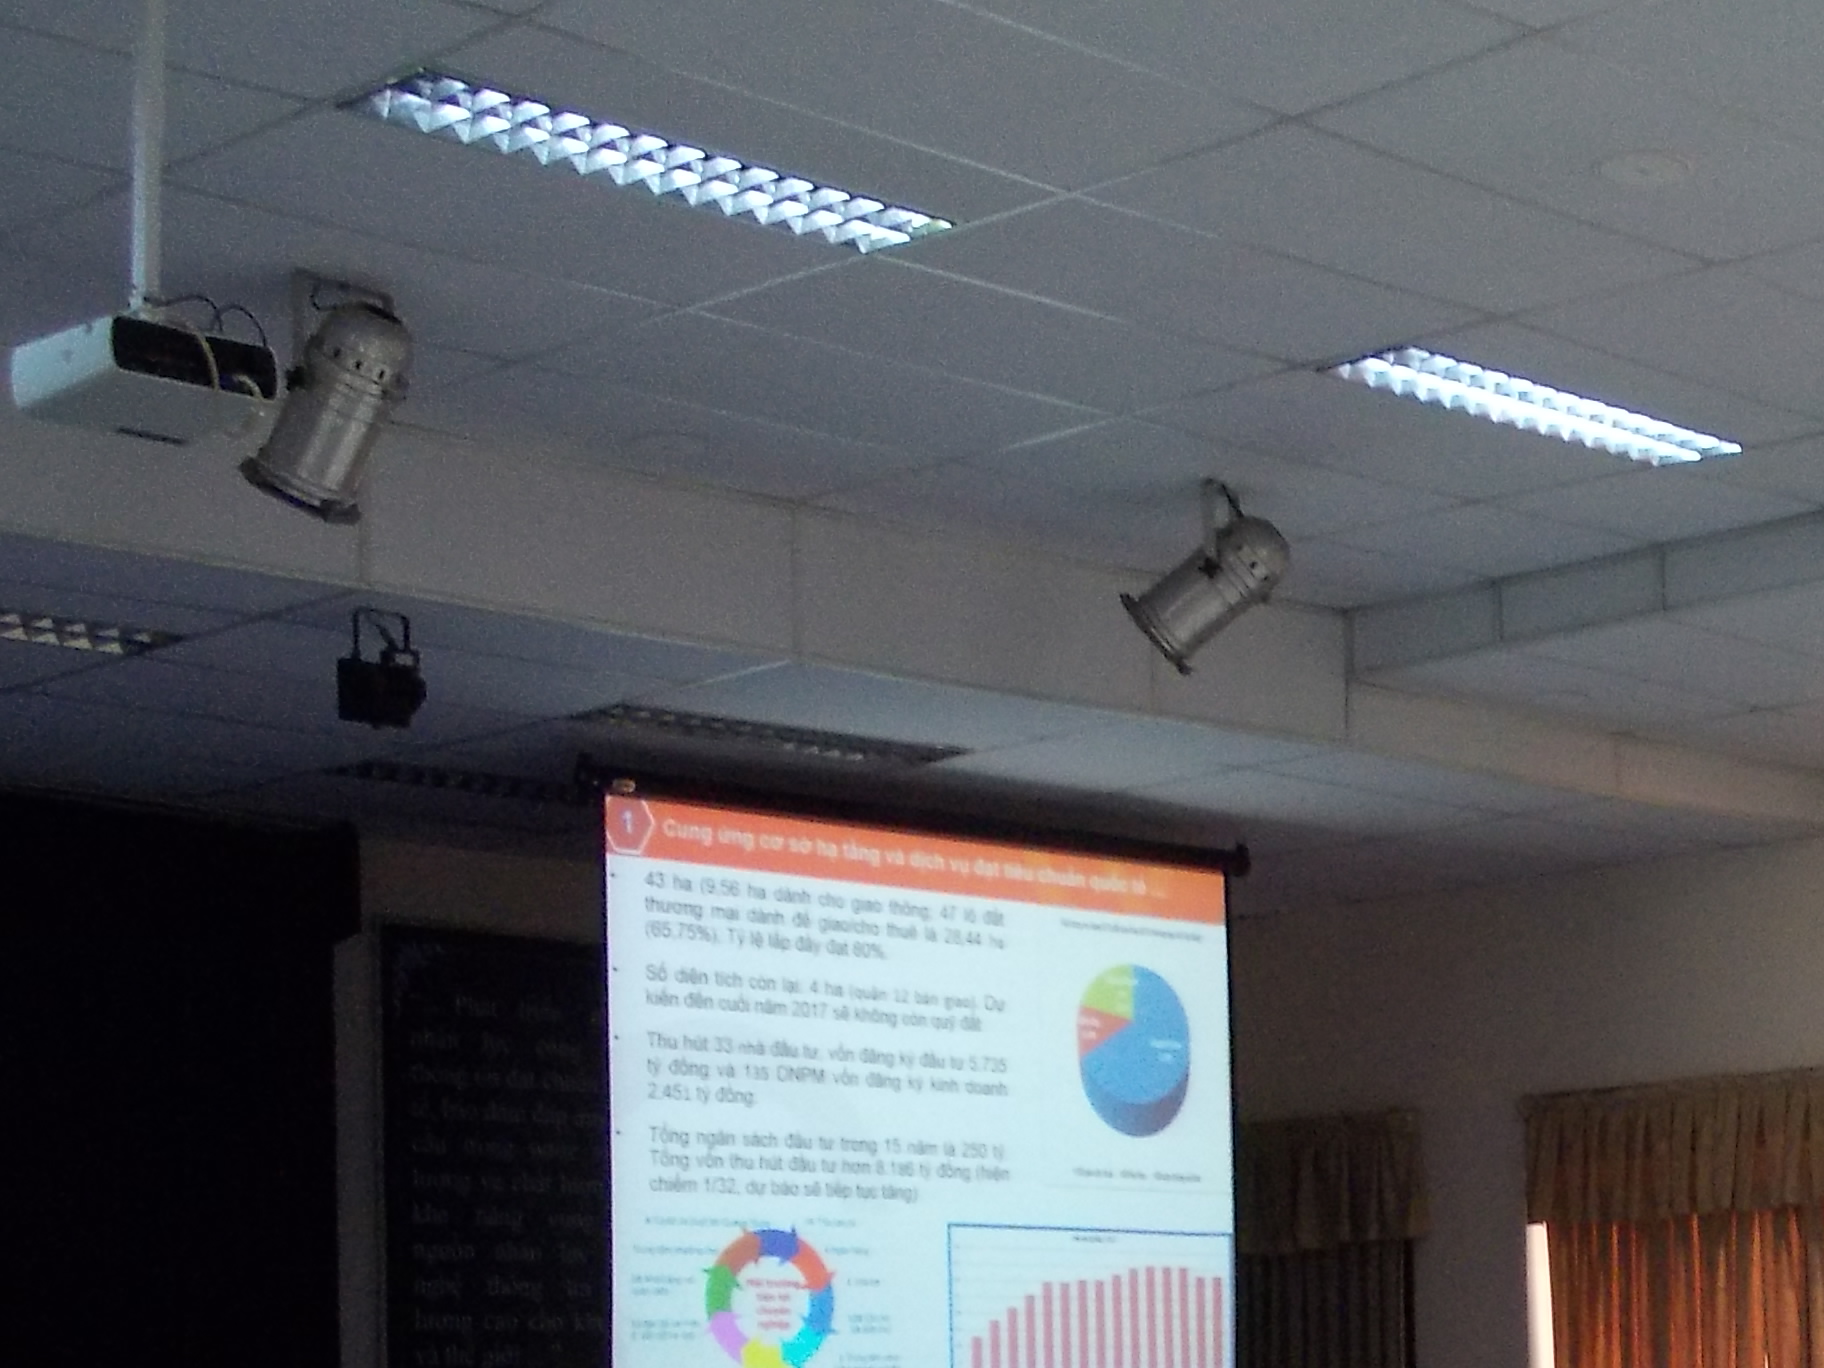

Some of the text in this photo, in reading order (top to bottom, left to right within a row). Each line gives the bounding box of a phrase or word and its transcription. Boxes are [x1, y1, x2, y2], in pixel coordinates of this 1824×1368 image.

[622, 810, 633, 834] 1
[663, 819, 713, 847] Cung
[644, 871, 665, 889] 43
[672, 874, 692, 892] ha
[647, 1030, 678, 1050] Thu
